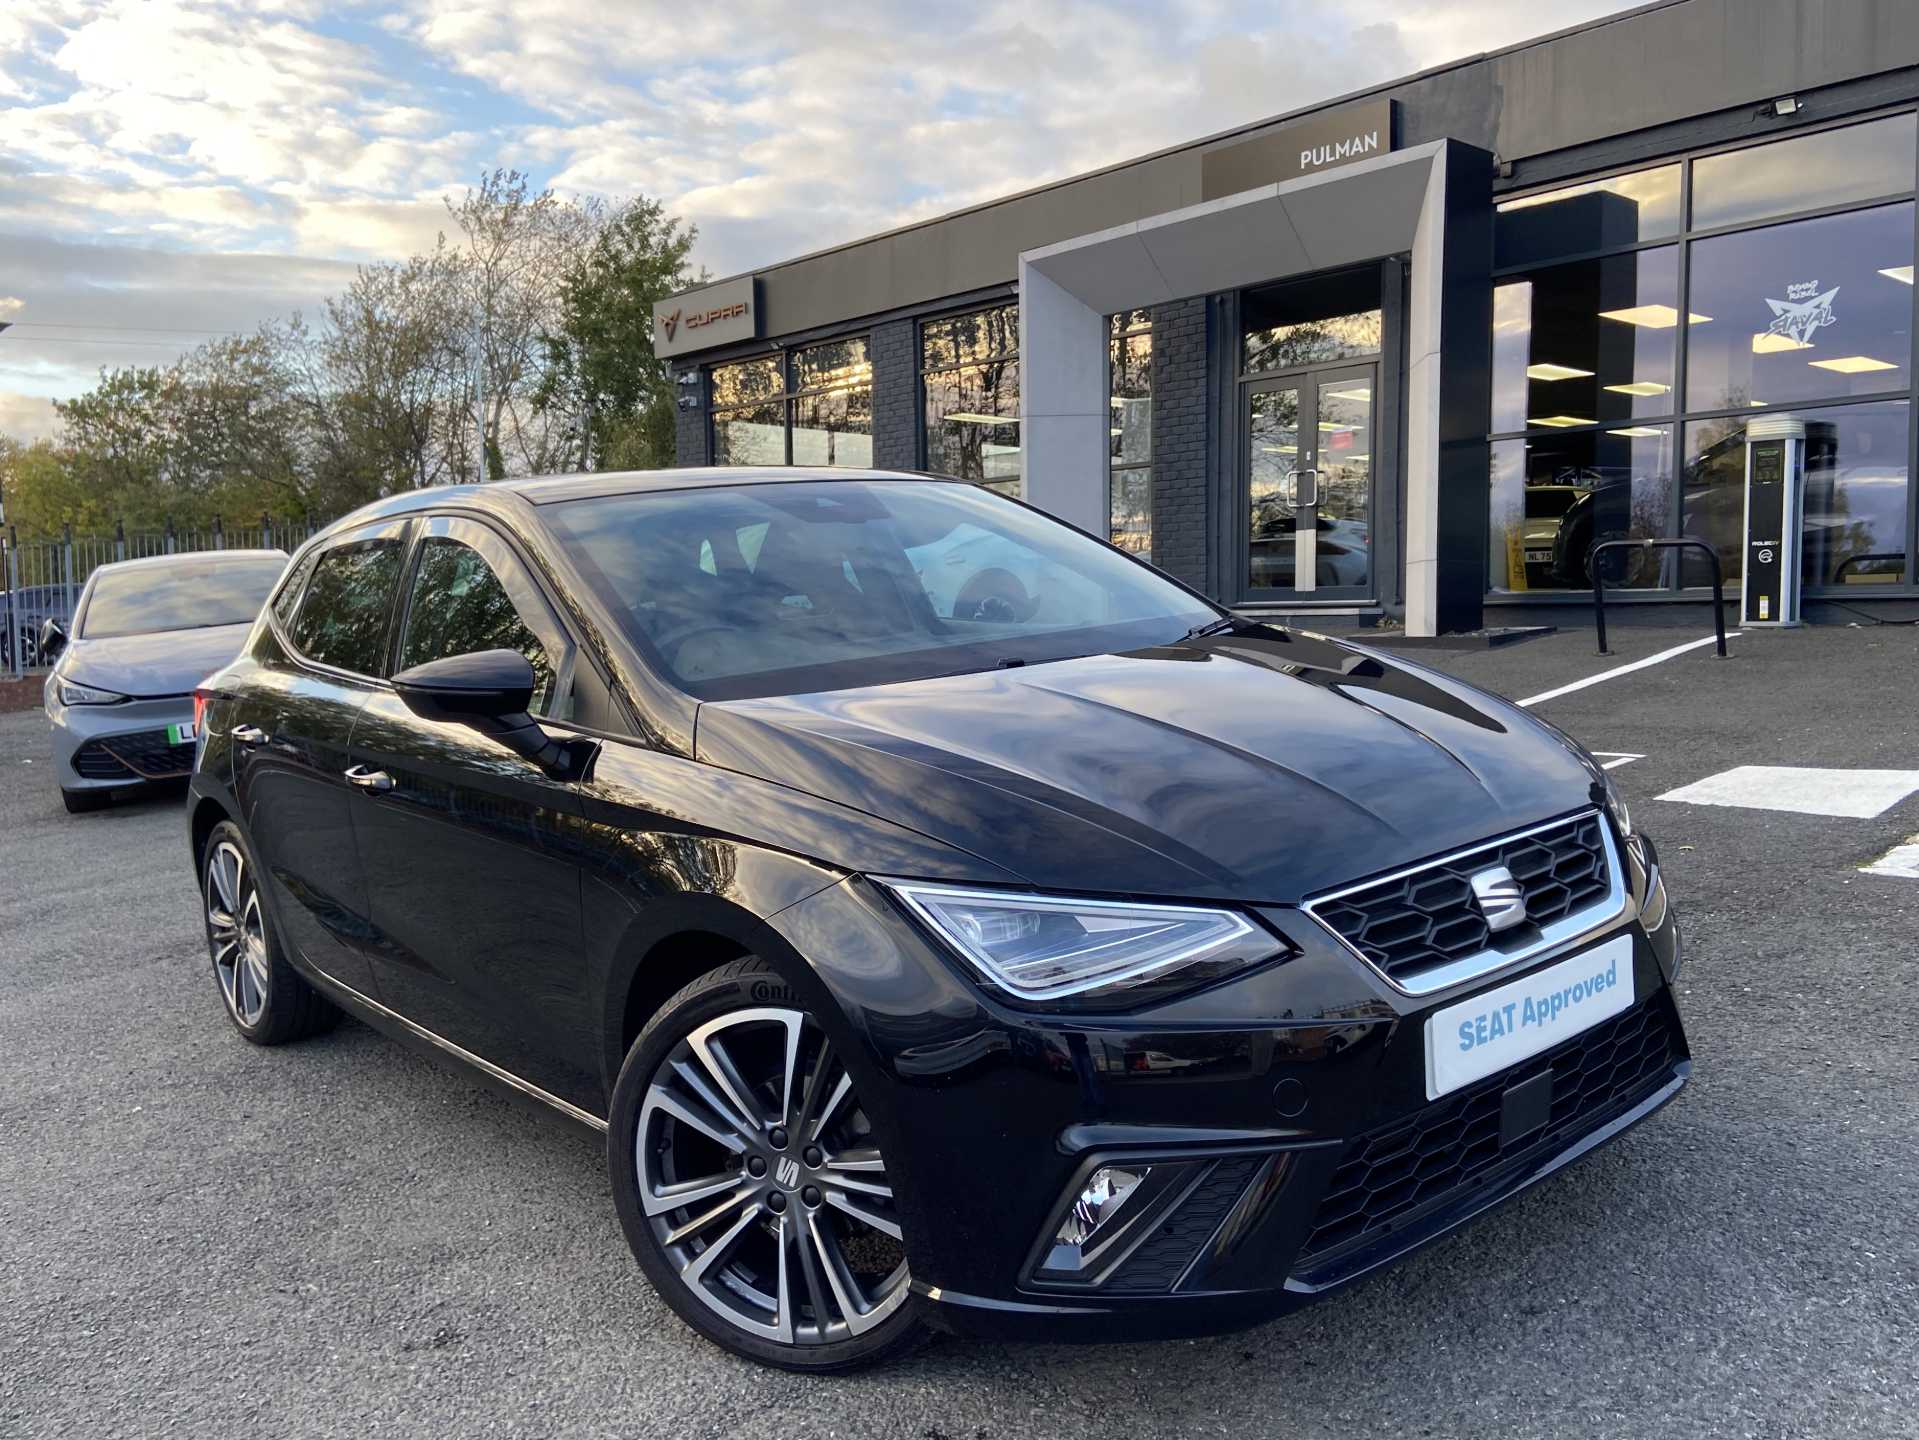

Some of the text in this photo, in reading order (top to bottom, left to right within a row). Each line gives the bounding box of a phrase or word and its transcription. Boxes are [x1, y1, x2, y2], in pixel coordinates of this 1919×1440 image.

[1300, 131, 1377, 169] PULMAN
[686, 302, 748, 328] CUPRA
[1458, 959, 1618, 1052] SEAT Approved
